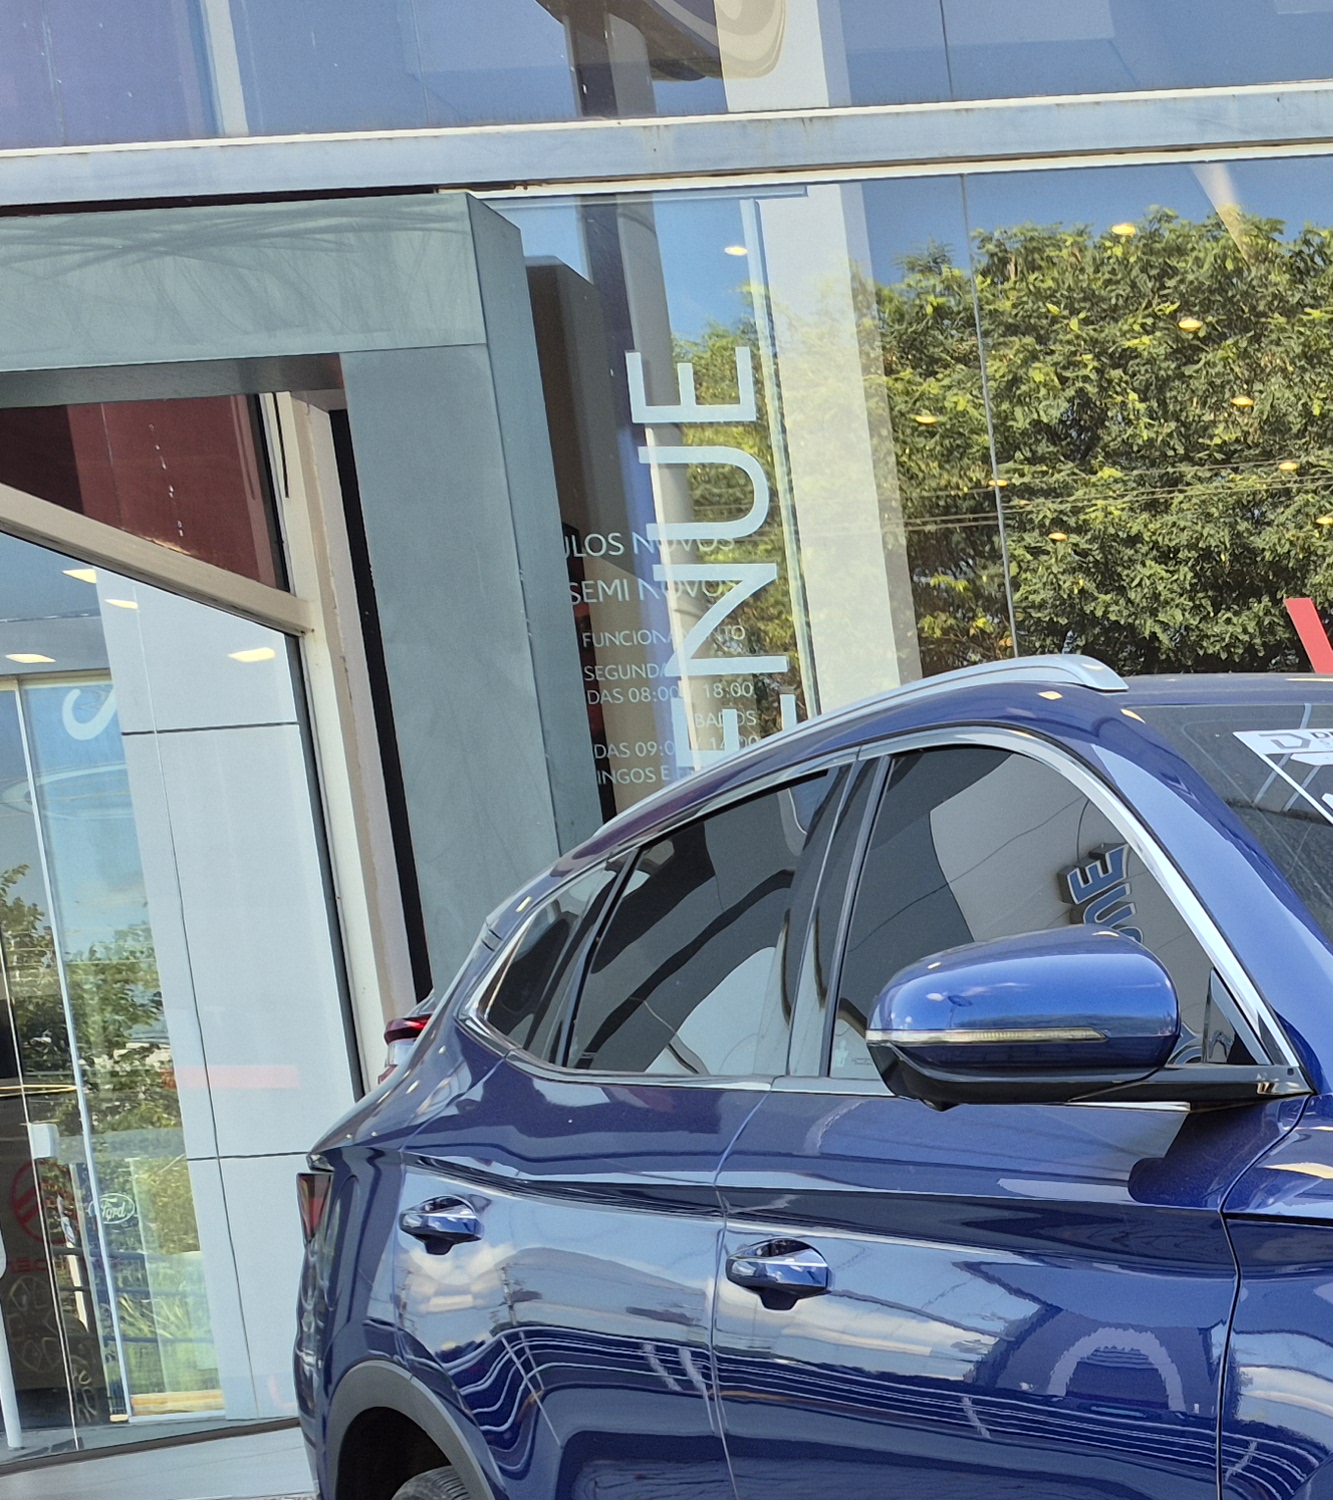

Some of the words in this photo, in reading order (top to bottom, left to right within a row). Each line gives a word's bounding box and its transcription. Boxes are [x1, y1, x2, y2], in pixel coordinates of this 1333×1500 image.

[569, 578, 629, 605] SEMI
[587, 688, 624, 705] DAS
[594, 743, 630, 759] DAS
